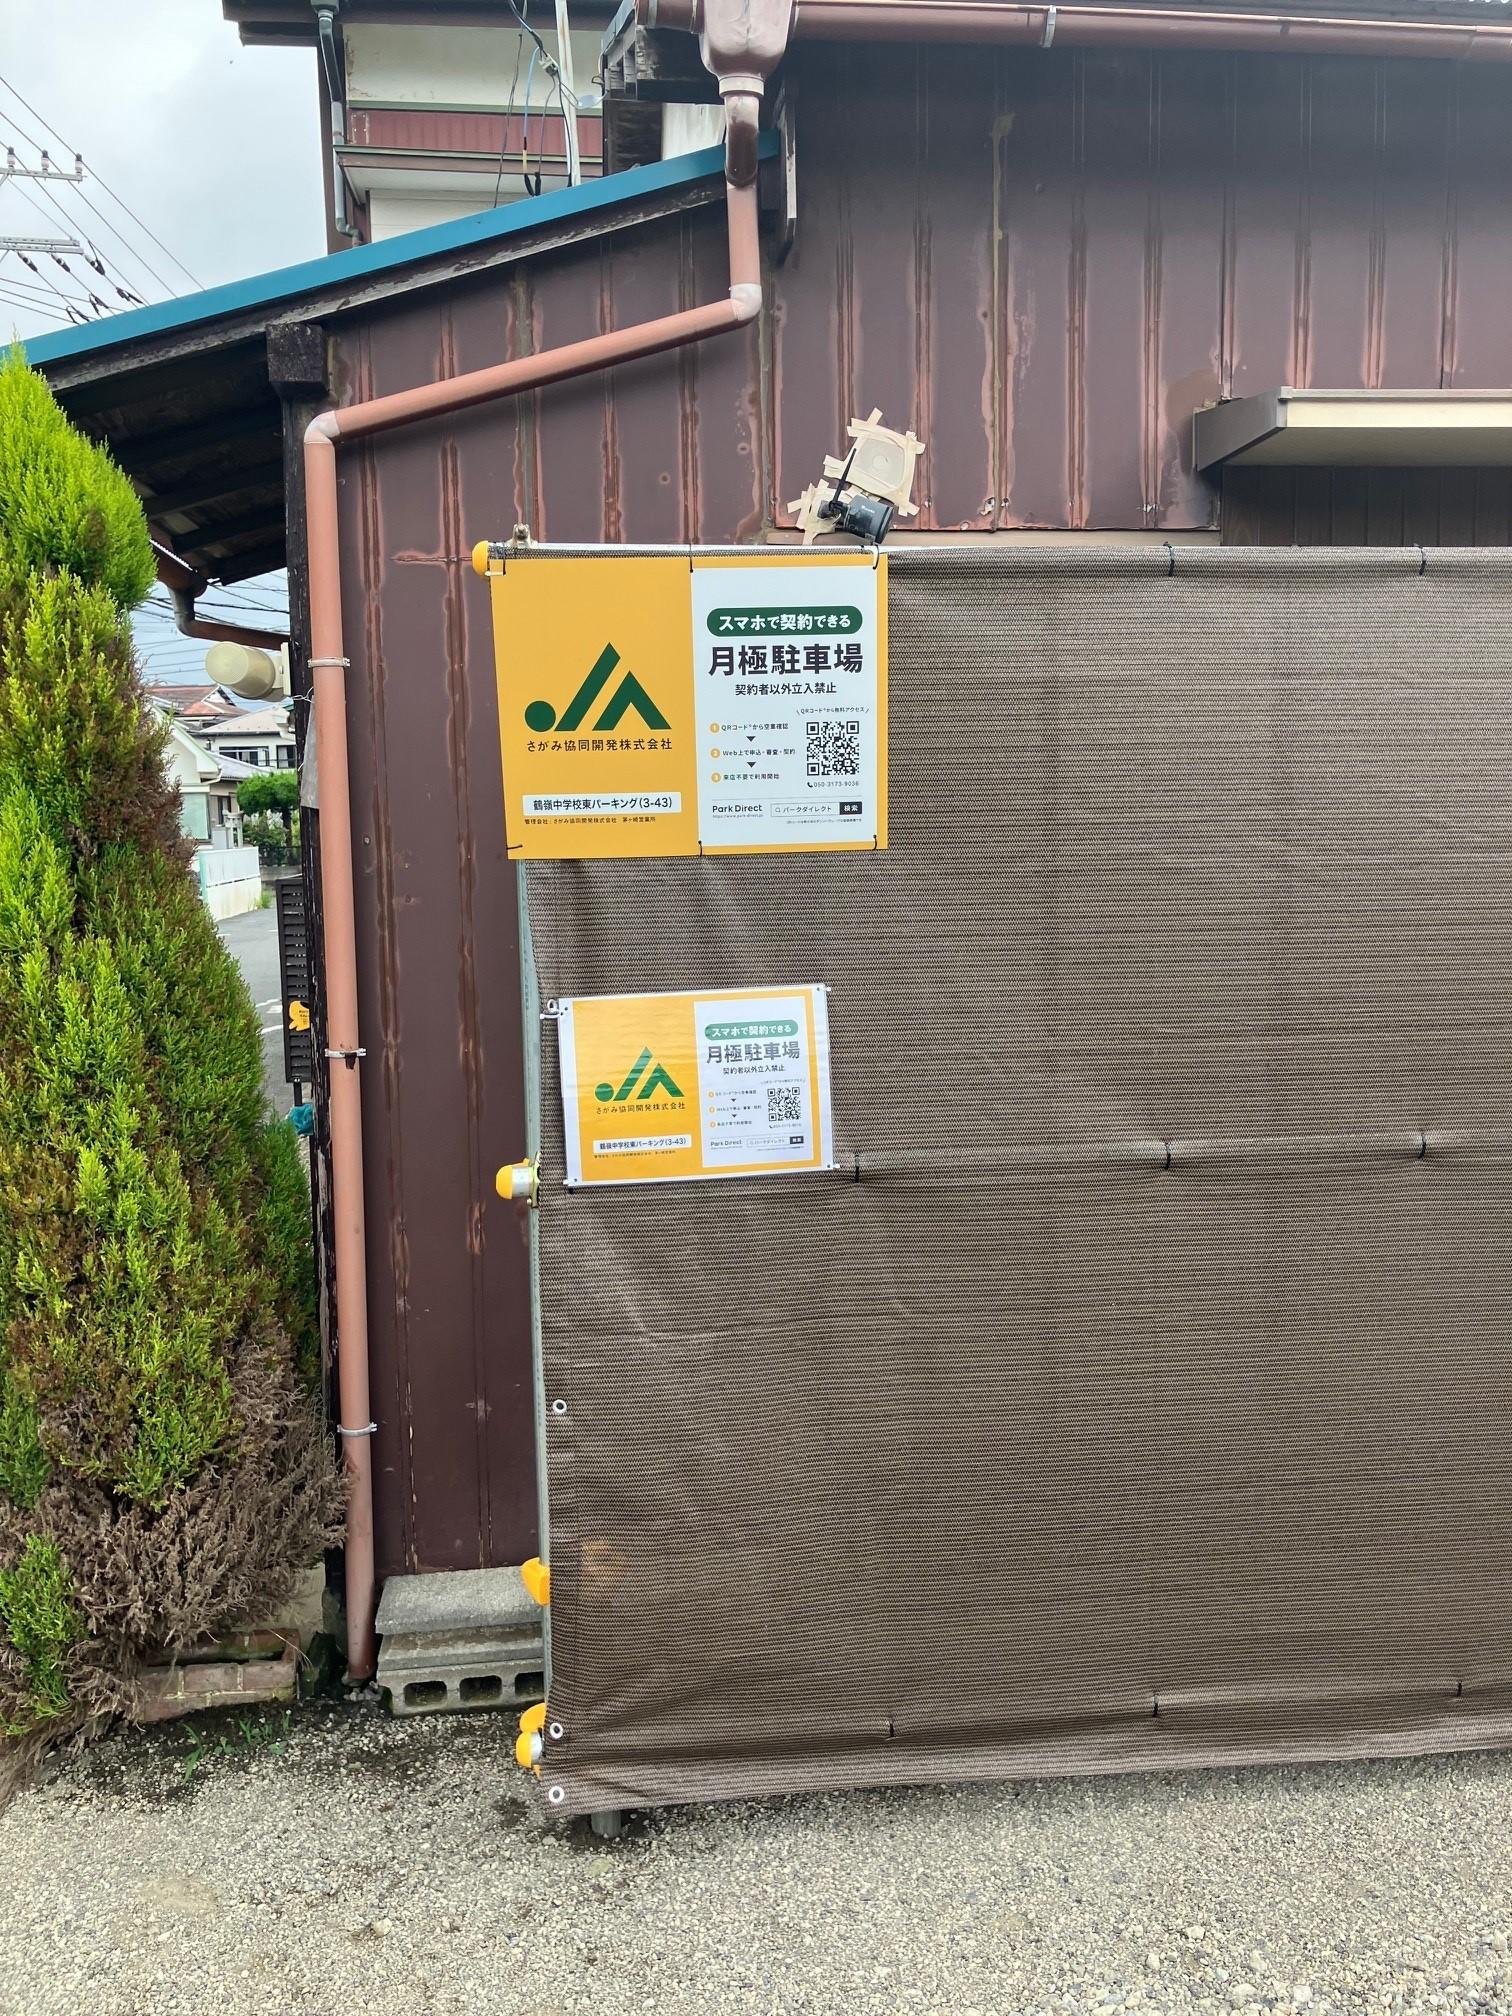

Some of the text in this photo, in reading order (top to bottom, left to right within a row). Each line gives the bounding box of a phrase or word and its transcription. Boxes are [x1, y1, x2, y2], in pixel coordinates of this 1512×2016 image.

[718, 613, 851, 631] スマホで契約できる
[708, 643, 864, 677] 月極駐車場
[735, 682, 837, 696] 契約者以外立入禁止
[526, 737, 673, 752] さがみ協同開発株式会社
[533, 796, 673, 812] 鶴嶺中学校東パーキング(3-43)
[712, 803, 763, 813] Park Direct
[782, 805, 832, 814] パークダイレクト
[843, 804, 860, 813] 検索
[711, 1024, 792, 1038] スマホで契約できる
[706, 1041, 801, 1065] 月極駐車場
[722, 1064, 785, 1076] 契約者以外立入禁止
[596, 1102, 687, 1115] さがみ協同開発株式会社
